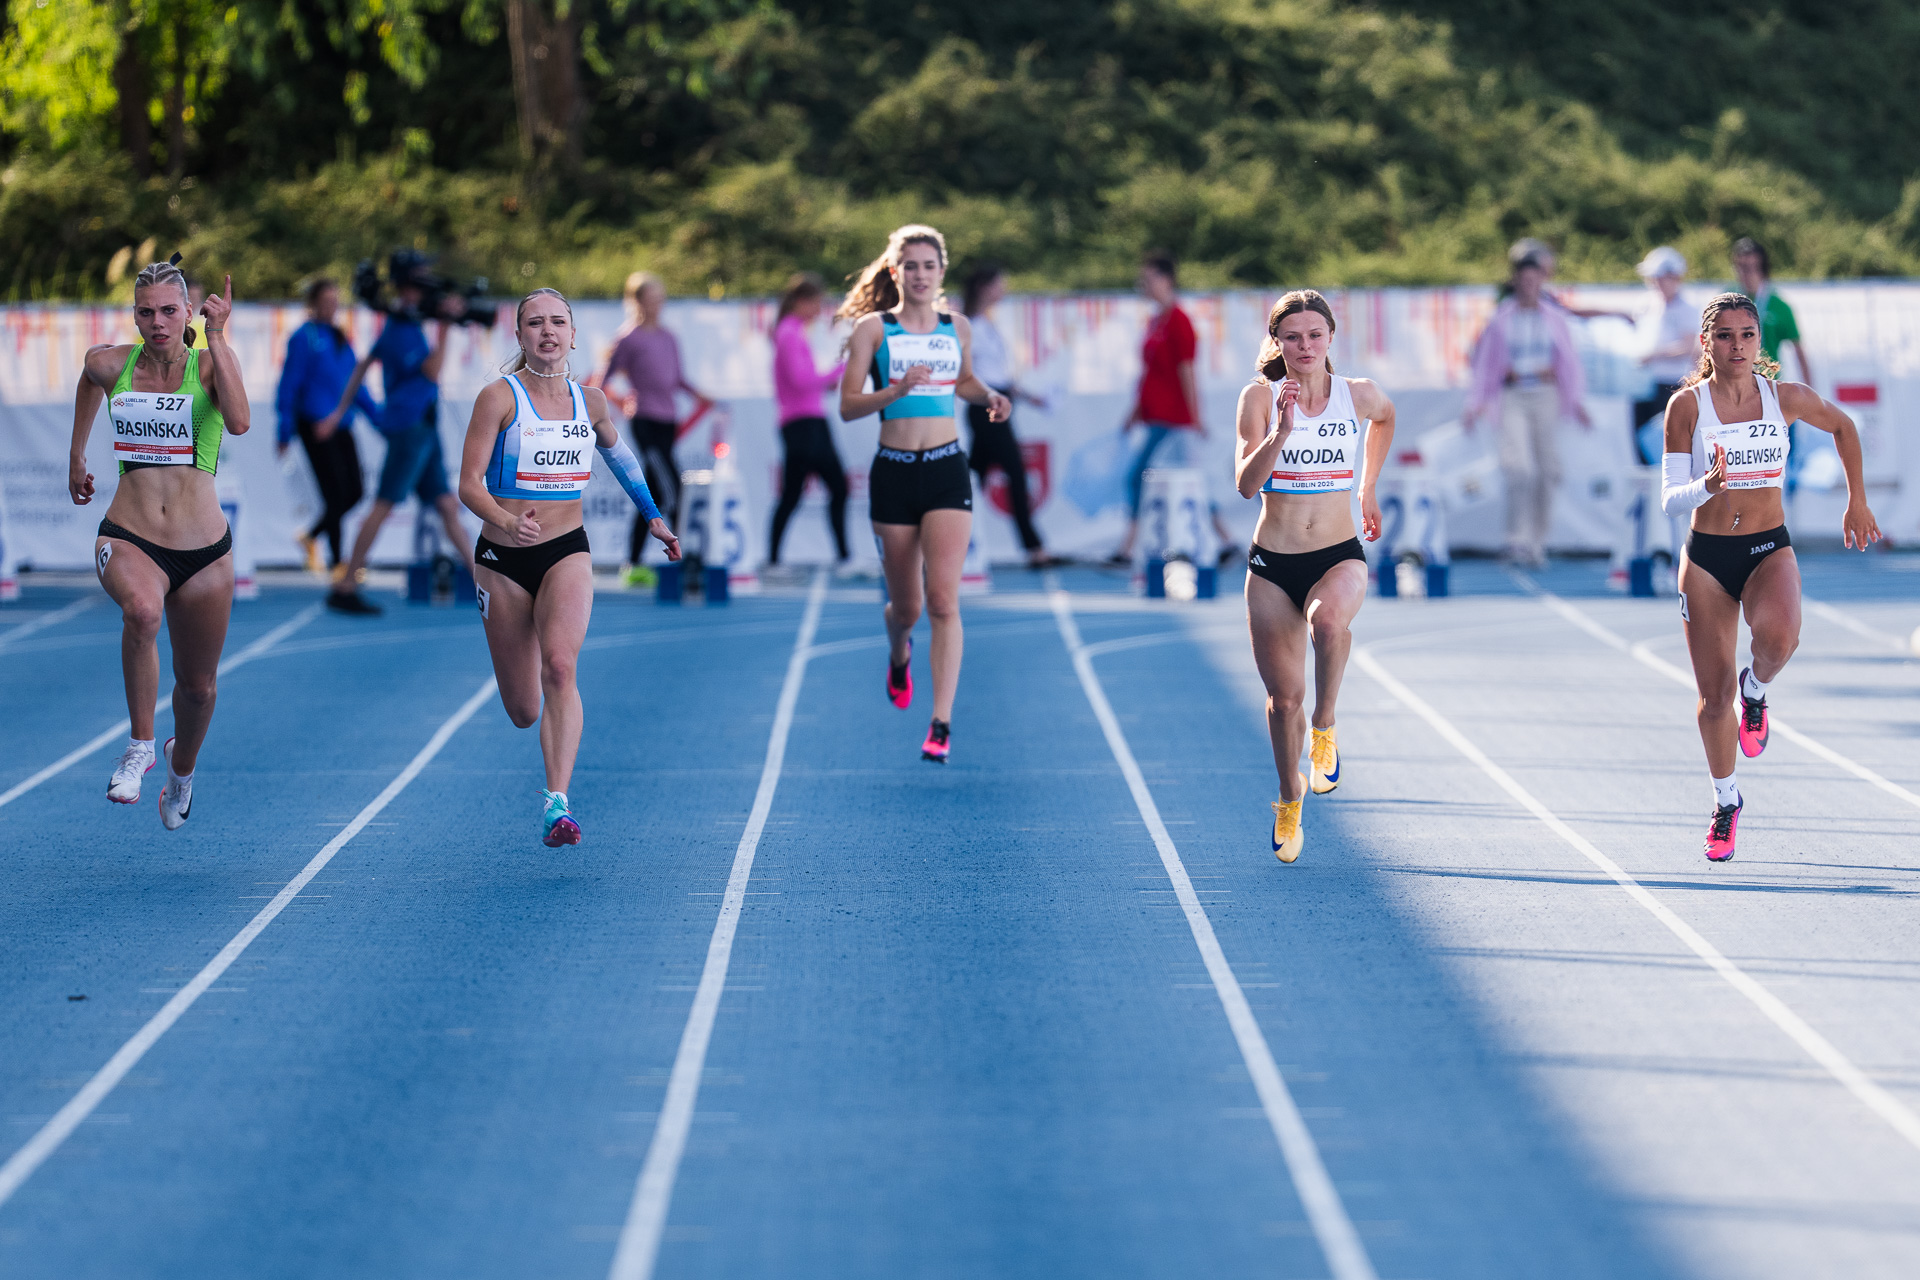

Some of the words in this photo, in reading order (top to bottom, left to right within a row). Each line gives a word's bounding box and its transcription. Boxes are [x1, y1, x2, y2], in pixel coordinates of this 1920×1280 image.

[155, 396, 186, 411] 527
[115, 418, 189, 438] BASIŃSKA
[562, 424, 589, 438] 548
[1318, 422, 1346, 437] 678
[1748, 424, 1778, 438] 272
[131, 453, 154, 461] LUBLIN
[534, 450, 582, 466] GUZIK
[880, 447, 917, 463] PRO
[922, 442, 959, 462] NIKE
[1281, 448, 1345, 464] WOJDA
[1708, 446, 1783, 466] WÓBLEWSKA
[724, 497, 745, 566] 5
[1750, 541, 1775, 555] JAKO
[100, 547, 109, 569] 6
